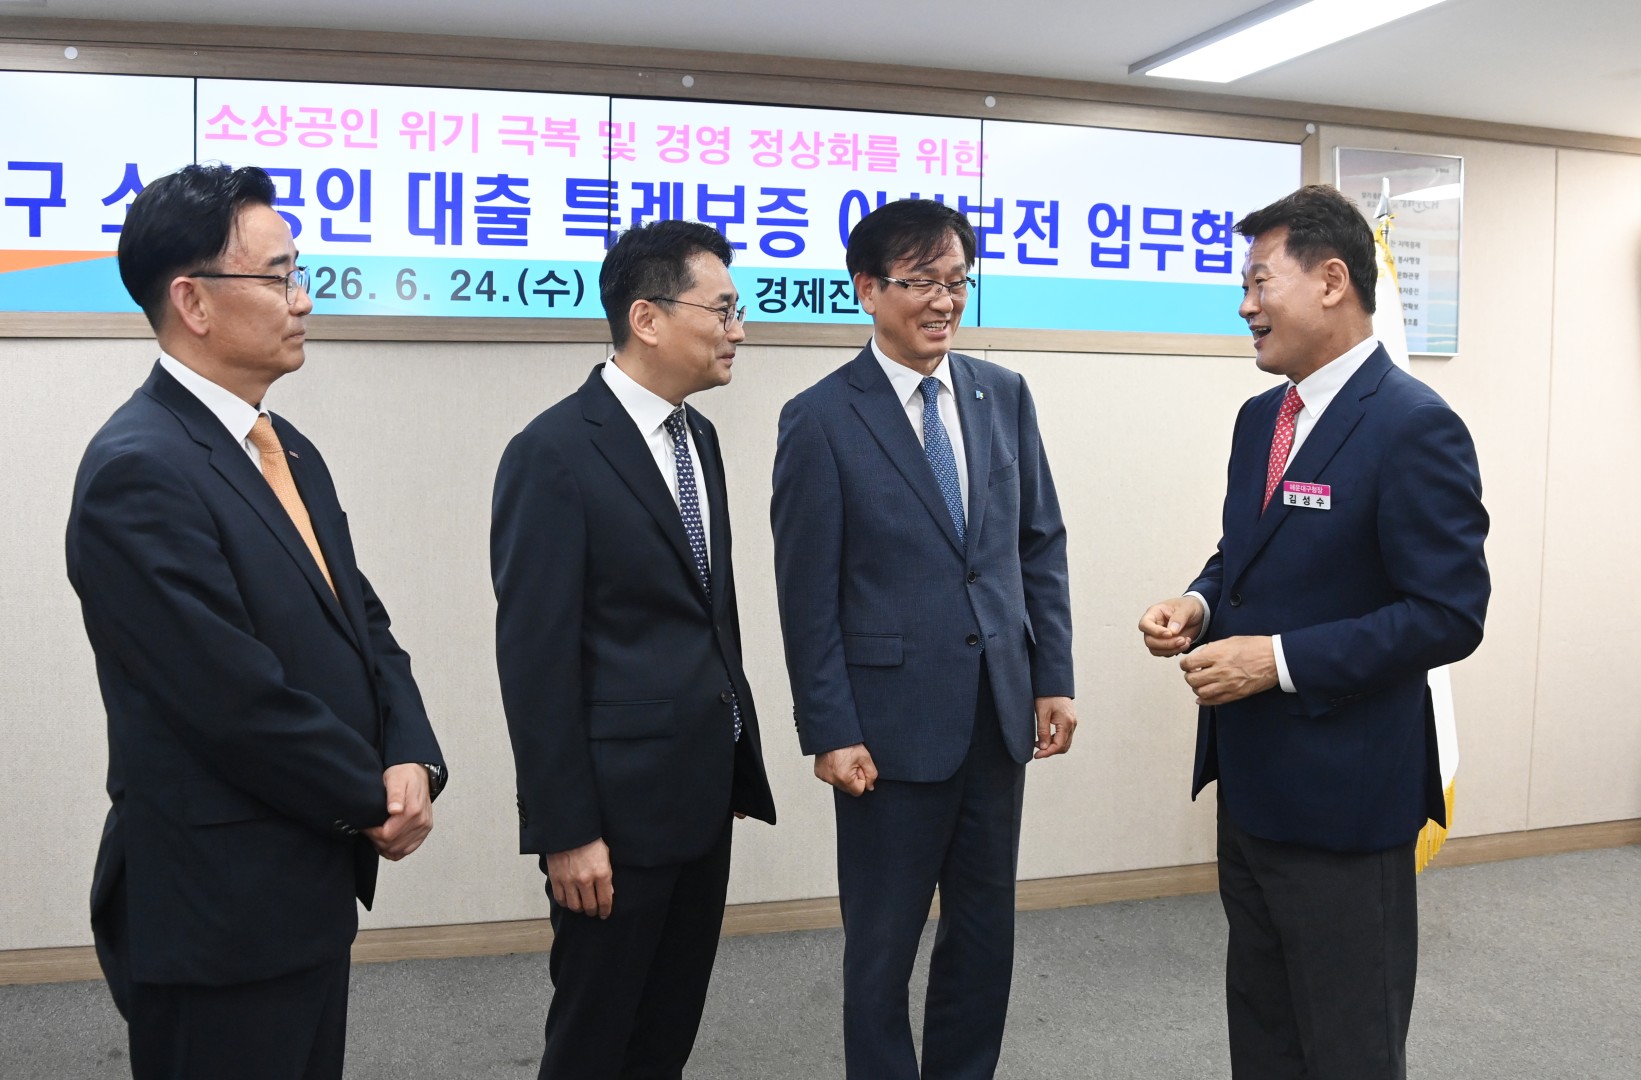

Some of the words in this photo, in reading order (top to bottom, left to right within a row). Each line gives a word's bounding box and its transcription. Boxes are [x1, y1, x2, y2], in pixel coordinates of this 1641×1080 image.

[205, 105, 378, 148] 소상공인
[399, 111, 479, 153] 위기
[498, 115, 580, 157] 극복
[599, 121, 637, 162] 및
[656, 124, 731, 166] 경영
[749, 129, 900, 173] 정상화를
[916, 138, 988, 177] 위한
[5, 161, 66, 238] 구
[101, 163, 372, 243] 소공인
[408, 171, 532, 247] 대출
[1088, 203, 1254, 274] 업무협
[395, 268, 431, 301] 6.
